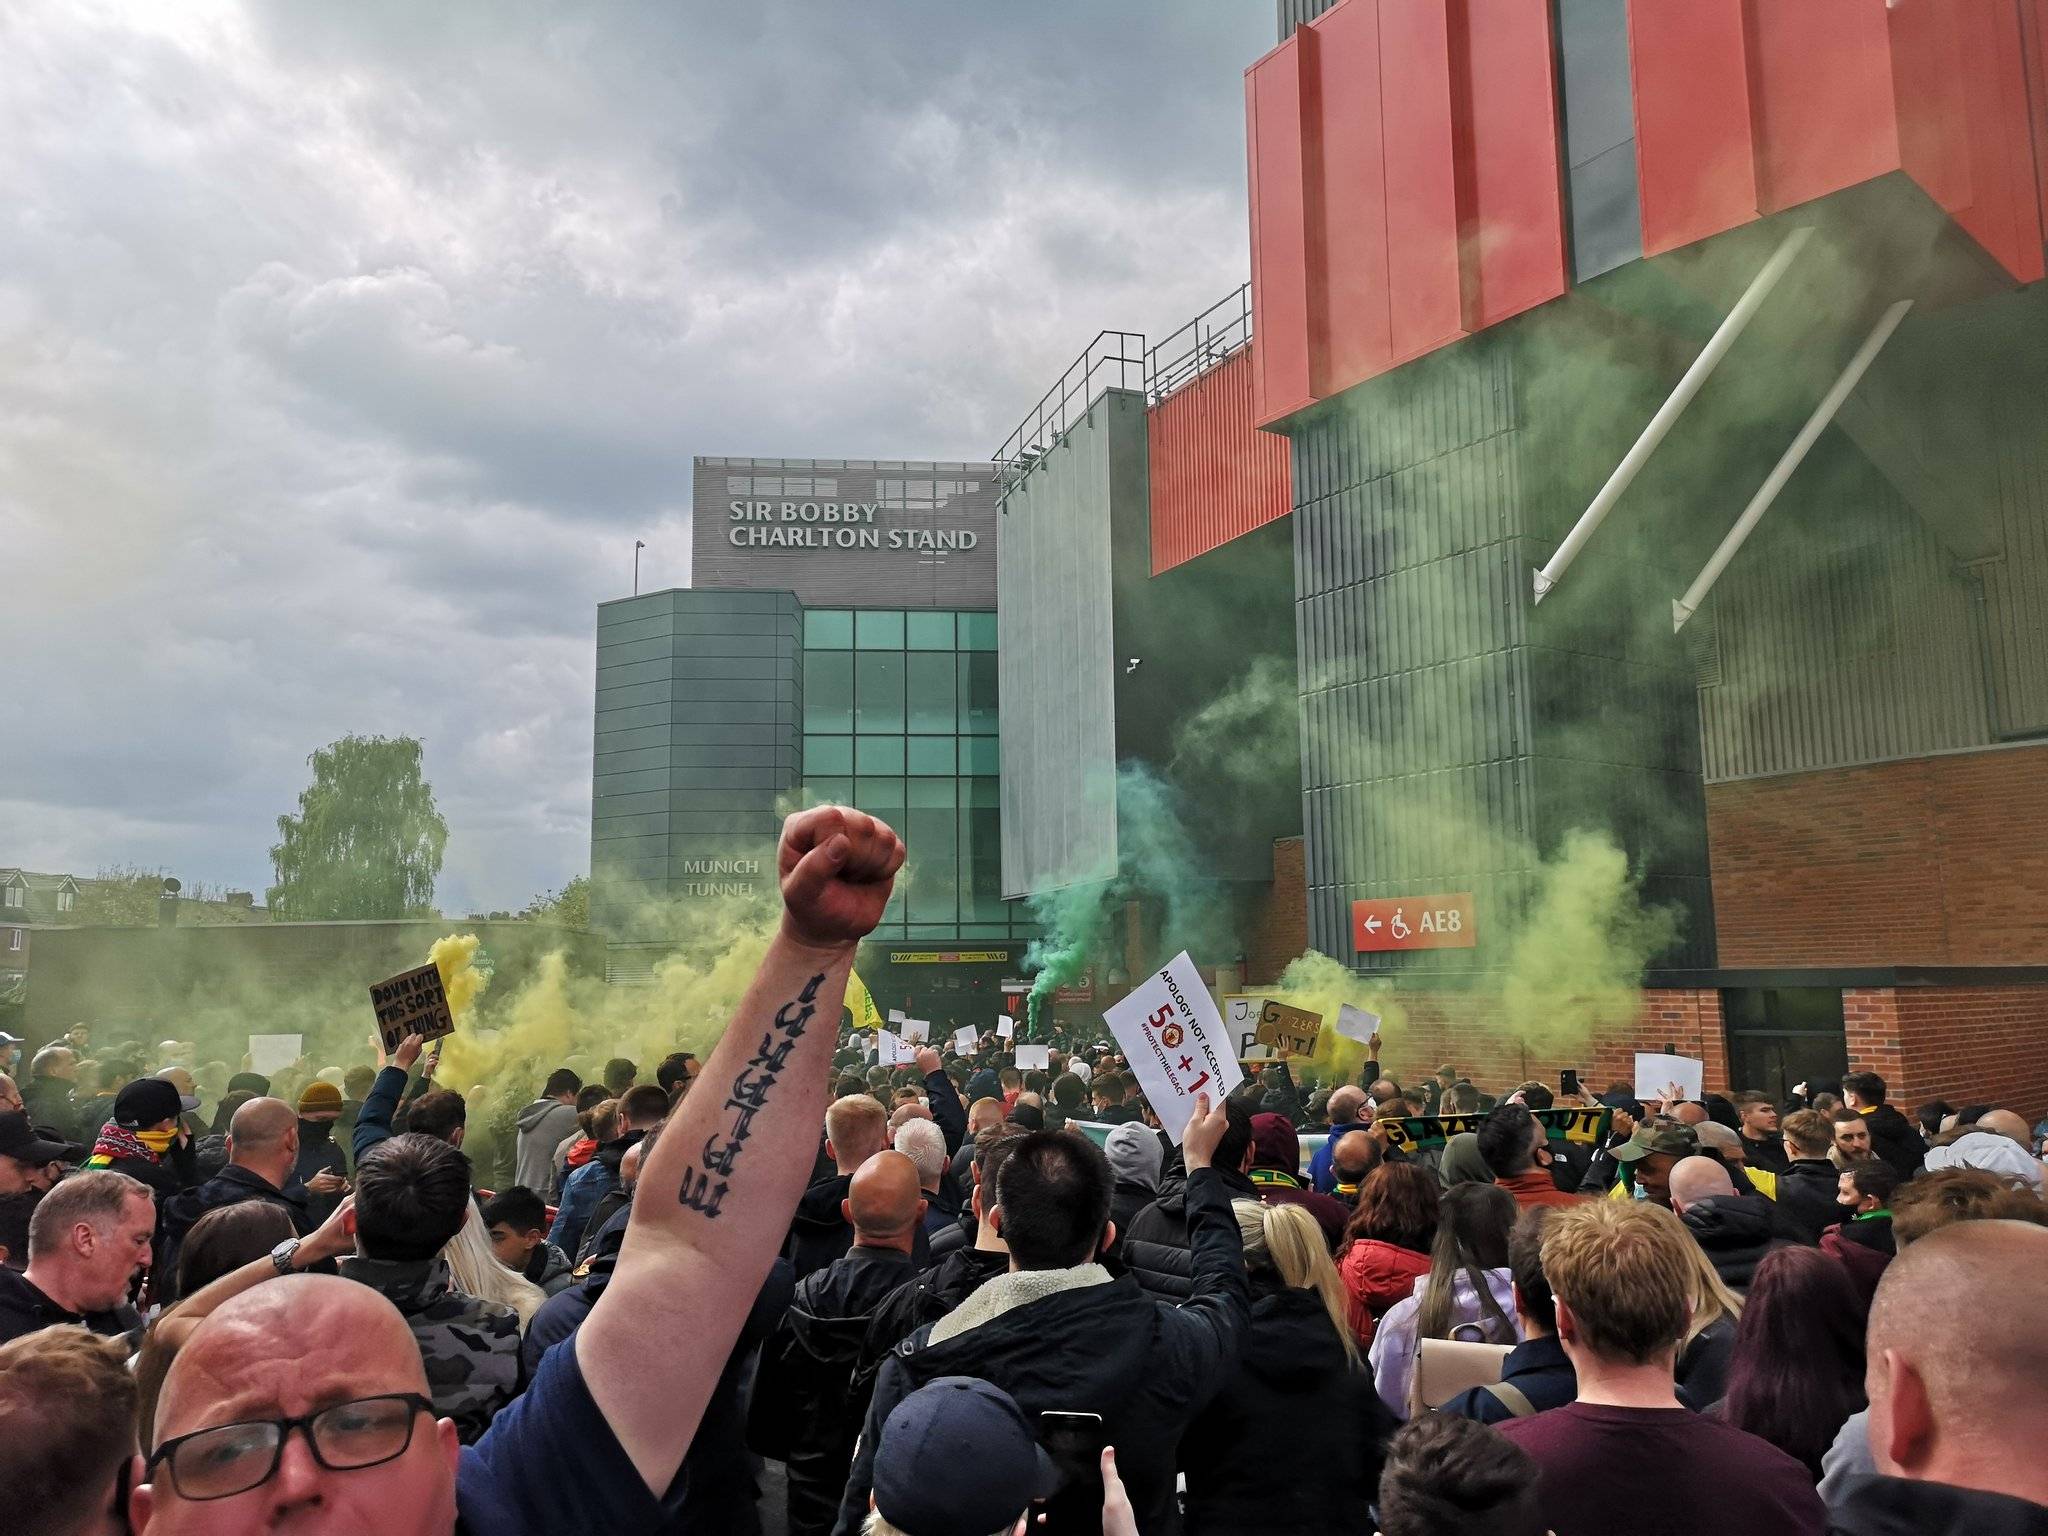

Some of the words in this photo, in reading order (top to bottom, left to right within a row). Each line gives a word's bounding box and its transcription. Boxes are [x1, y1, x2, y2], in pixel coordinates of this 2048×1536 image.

[729, 501, 772, 521] SIR
[781, 502, 878, 523] BOBBY
[729, 526, 880, 548] CHARLTON
[888, 529, 978, 550] STAND
[684, 860, 759, 874] MUNICH
[1420, 909, 1462, 933] AE8
[373, 979, 410, 1005] DOWN
[378, 999, 405, 1025] THIS
[405, 987, 443, 1013] SORT
[1160, 970, 1193, 1018] APOLOGY
[1188, 1018, 1206, 1042] NOT
[1202, 1044, 1226, 1097] ACCEPTED
[1141, 1022, 1185, 1097] #PROTECTTHELEGACY
